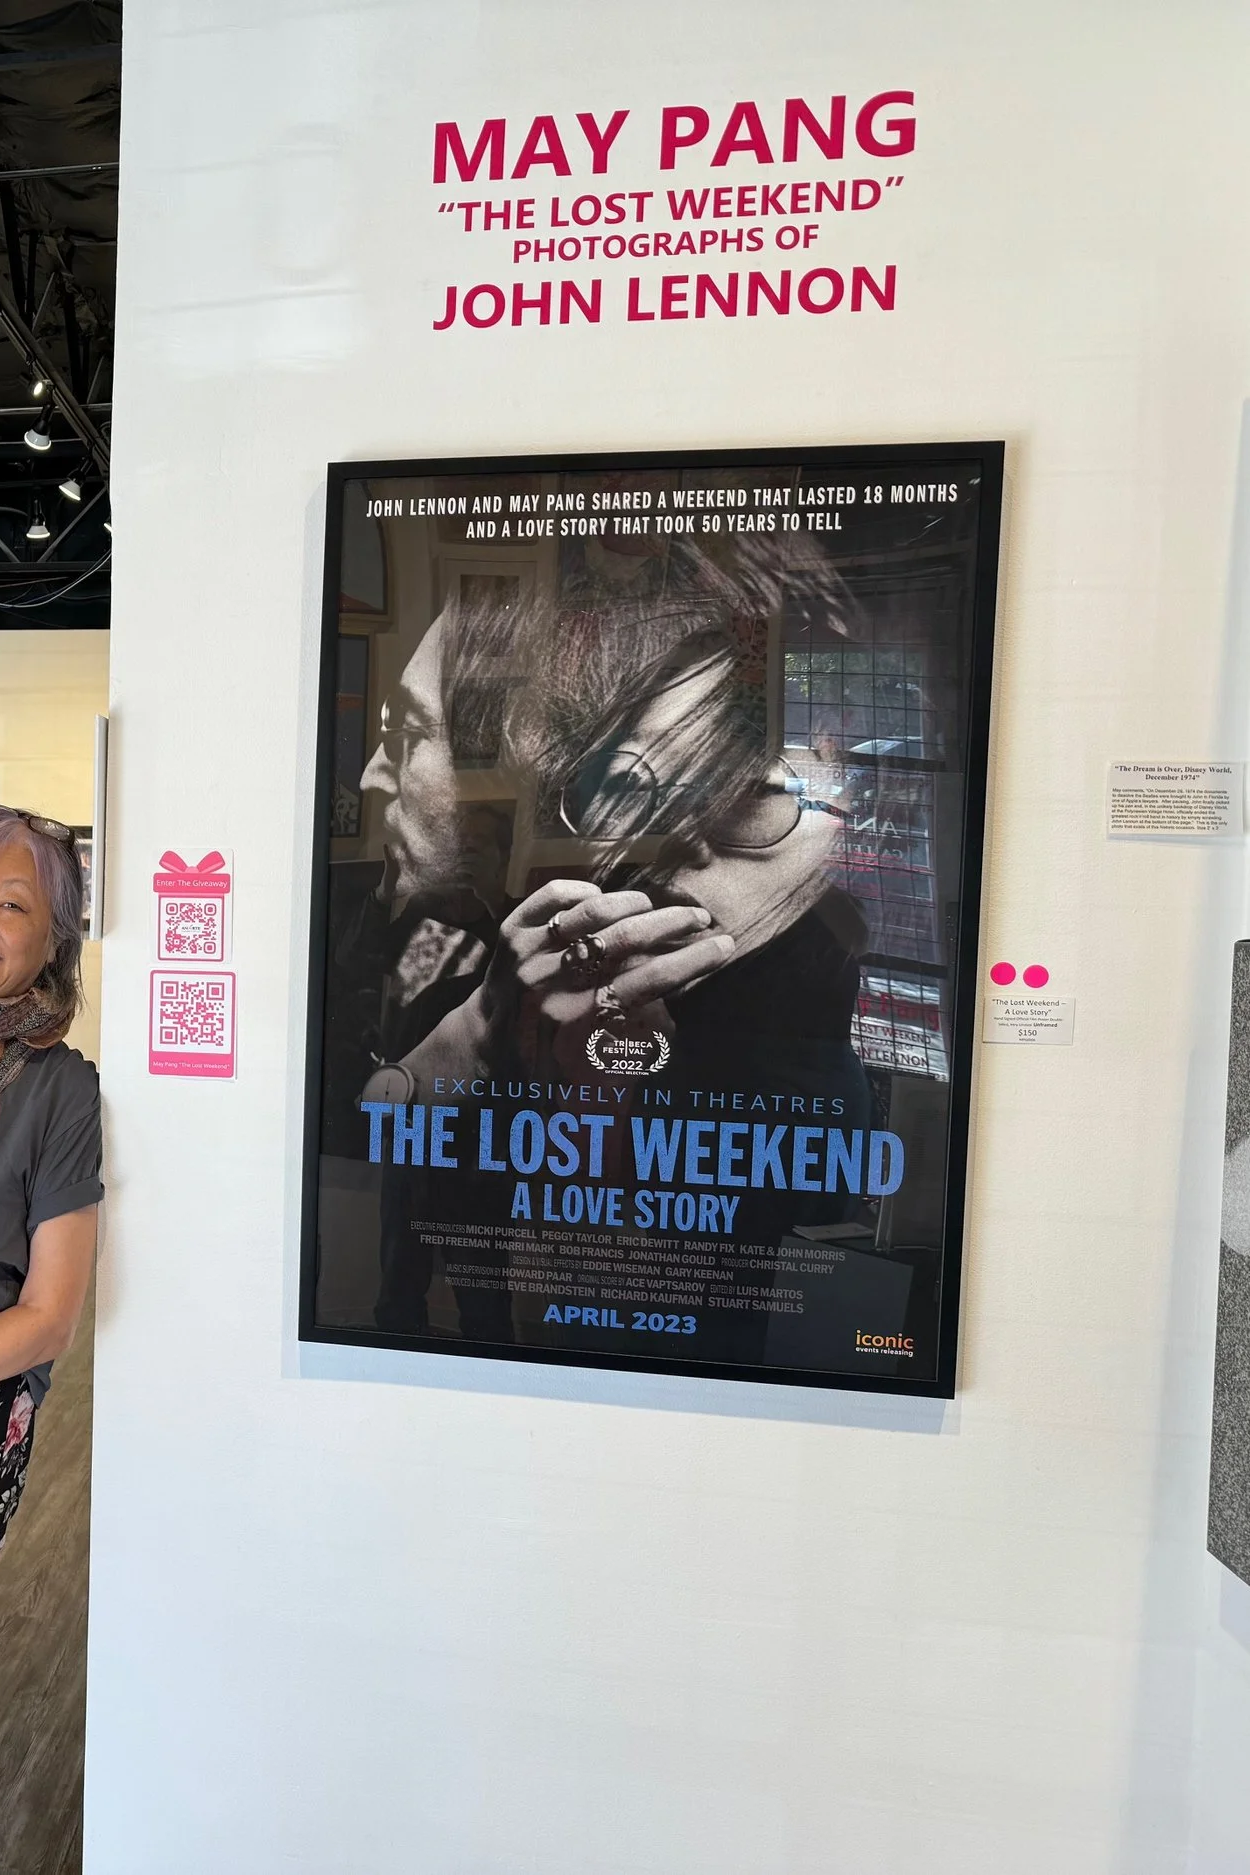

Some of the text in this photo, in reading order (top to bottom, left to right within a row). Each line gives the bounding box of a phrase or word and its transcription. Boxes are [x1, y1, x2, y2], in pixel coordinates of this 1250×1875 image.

[432, 90, 916, 184] MAY PANG
[550, 191, 653, 228] LOST
[513, 224, 820, 263] PHOTOGRAPHS OF
[432, 265, 897, 330] JOHN LENNON
[367, 484, 958, 518] JOHN LENNON AND MAY PANG SHARED A WEEKEND THAT LASTED 18 MONTHS
[466, 512, 842, 539] AND A LOVE STORY THAT TOOK 50 YEARS TO TELL
[1185, 766, 1205, 774] Disney
[192, 880, 227, 888] Giveaway
[611, 1060, 643, 1070] 2022
[434, 1078, 844, 1115] EXCLUSIVELY IN THEATRES
[360, 1102, 904, 1195] THE LOST WEEKEND
[510, 1182, 740, 1234] A LOVE STORY
[420, 1234, 444, 1245] FRED
[445, 1236, 490, 1248] FREEMAN
[495, 1240, 524, 1251] HARRI
[526, 1243, 554, 1253] MARK
[560, 1245, 580, 1255] BOB
[582, 1247, 624, 1259] FRANCIS
[628, 1250, 680, 1263] JONATHAN
[682, 1255, 715, 1266] GOULD
[750, 1260, 798, 1272] CHRISTAL
[800, 1263, 834, 1274] CURRY
[466, 1224, 493, 1235] MICKI
[495, 1227, 537, 1239] PURCELL
[542, 1230, 574, 1242] PEGGY
[575, 1233, 612, 1244] TAYLOR
[617, 1236, 639, 1247] ERIC
[641, 1237, 680, 1249] DEWITT
[684, 1240, 718, 1252] RANDY
[720, 1243, 735, 1253] FIX
[740, 1244, 765, 1255] KATE
[766, 1247, 774, 1256] &
[776, 1248, 803, 1258] JOHN
[805, 1250, 846, 1261] MORRIS
[502, 1267, 545, 1279] HOWARD
[546, 1271, 572, 1282] PAAR
[626, 1278, 645, 1288] ACE
[646, 1279, 705, 1292] VAPTSAROV
[737, 1286, 759, 1296] LUIS
[760, 1288, 803, 1300] MARTOS
[583, 1260, 611, 1271] EDDIE
[613, 1262, 660, 1275] WISEMAN
[665, 1266, 692, 1277] GARY
[693, 1269, 734, 1280] KEENAN
[507, 1280, 527, 1292] EVE
[529, 1282, 595, 1297] BRANDSTEIN
[601, 1288, 649, 1301] RICHARD
[650, 1292, 702, 1306] KAUFMAN
[708, 1296, 750, 1309] STUART
[752, 1300, 804, 1314] SAMUELS
[543, 1304, 697, 1334] APRIL 2023
[856, 1330, 914, 1349] iconic
[880, 1348, 913, 1357] releasing
